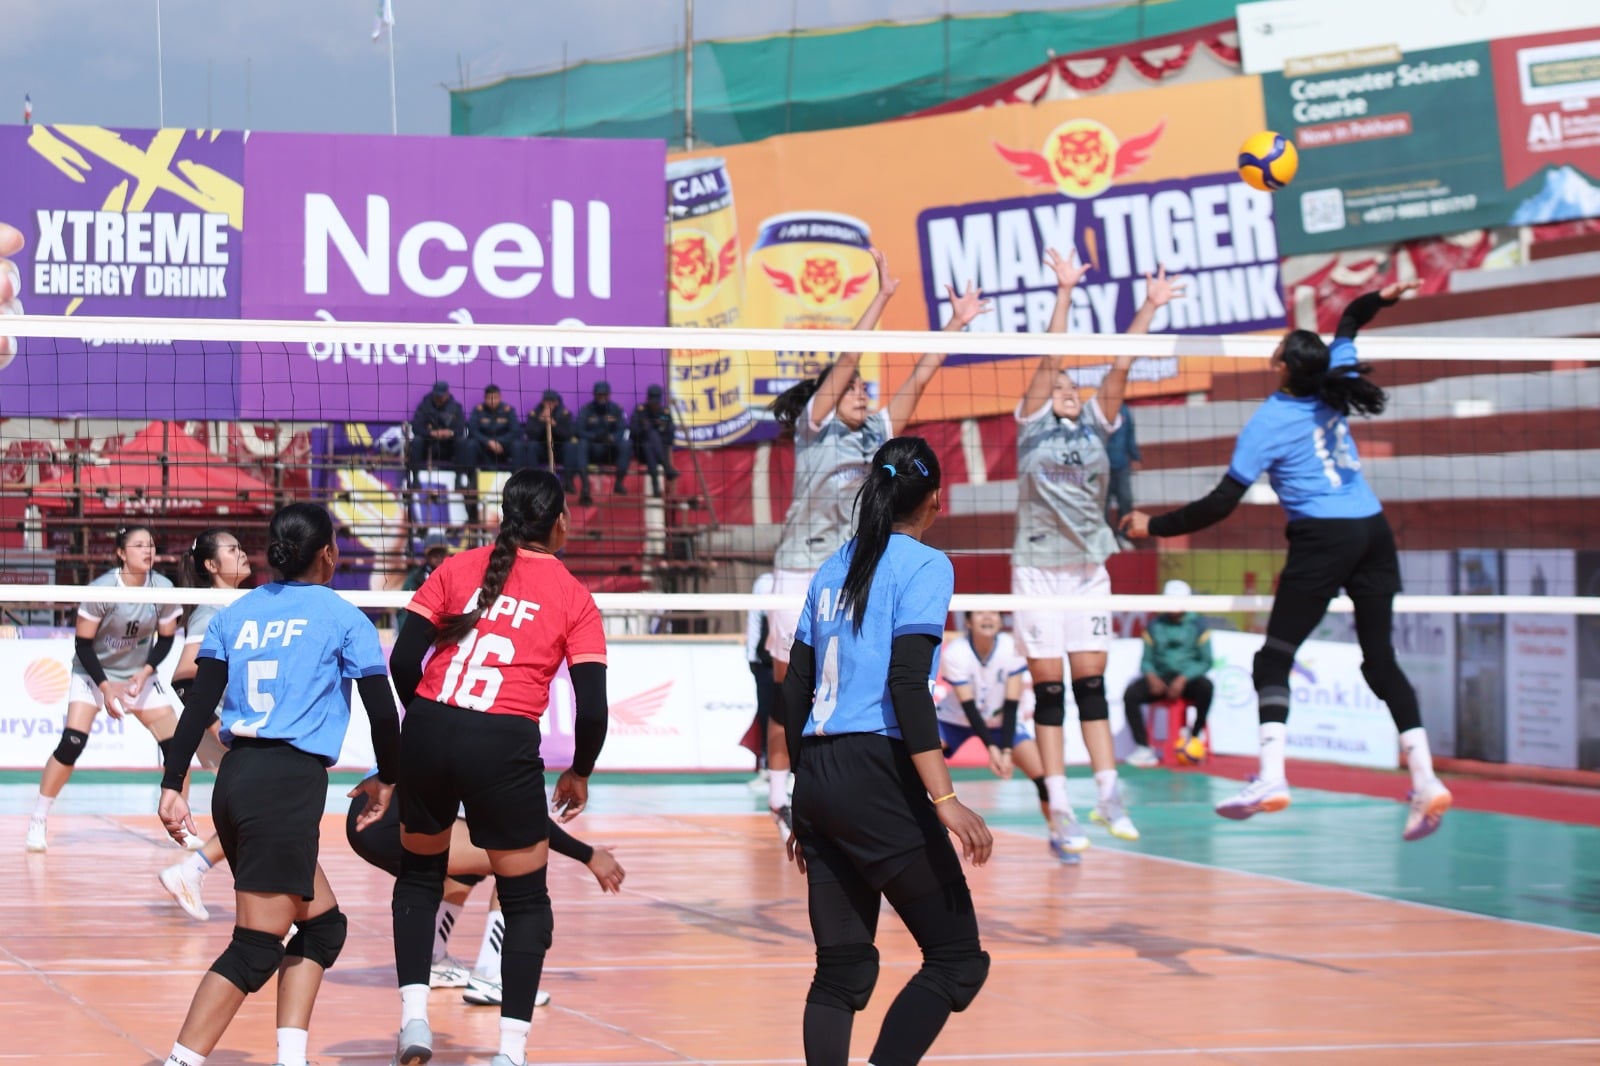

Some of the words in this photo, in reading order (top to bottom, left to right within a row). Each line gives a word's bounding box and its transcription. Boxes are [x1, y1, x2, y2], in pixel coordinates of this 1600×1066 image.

[1290, 71, 1395, 101] Computer
[1397, 59, 1480, 87] Science
[1293, 97, 1368, 123] Course
[673, 172, 719, 201] CAN
[35, 210, 229, 265] XTREME
[304, 193, 611, 299] Ncell
[928, 202, 1087, 300] MAX
[1092, 181, 1278, 279] TIGER
[34, 263, 137, 296] ENERGY
[145, 266, 227, 298] DRINK
[126, 620, 140, 637] 16
[233, 619, 309, 650] APF
[436, 627, 516, 713] 16
[230, 660, 279, 738] 5
